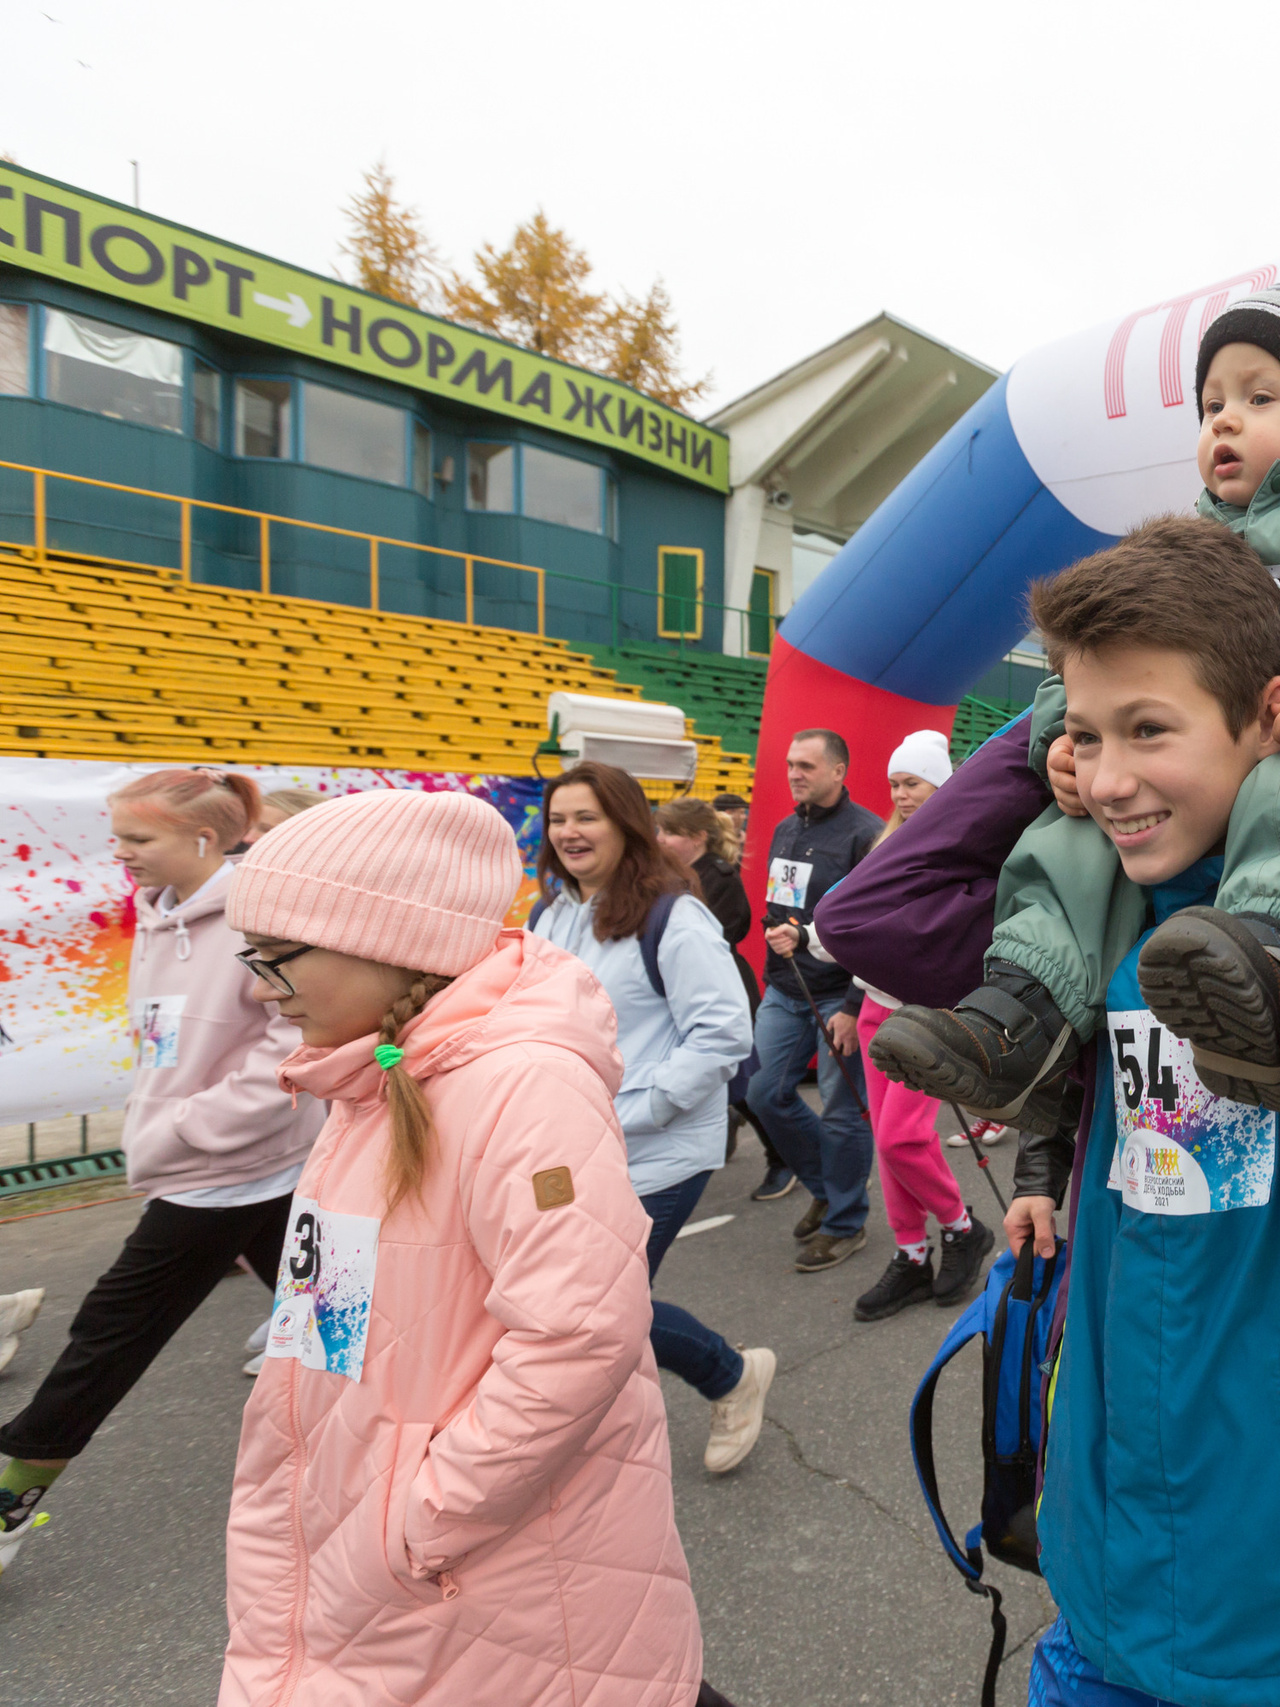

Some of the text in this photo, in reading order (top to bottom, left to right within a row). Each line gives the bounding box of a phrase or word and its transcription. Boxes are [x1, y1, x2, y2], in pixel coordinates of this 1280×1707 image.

[320, 295, 553, 406] НОРМА
[563, 379, 713, 476] ЖИЗНИ
[781, 865, 797, 884] 38
[1113, 1027, 1180, 1112] 54
[1144, 1175, 1185, 1186] ВСЕРОССИЙСКИЙ
[1143, 1184, 1157, 1195] ДЕНЬ
[1157, 1185, 1185, 1197] ХОДЬБЫ
[1154, 1197, 1169, 1207] 2021
